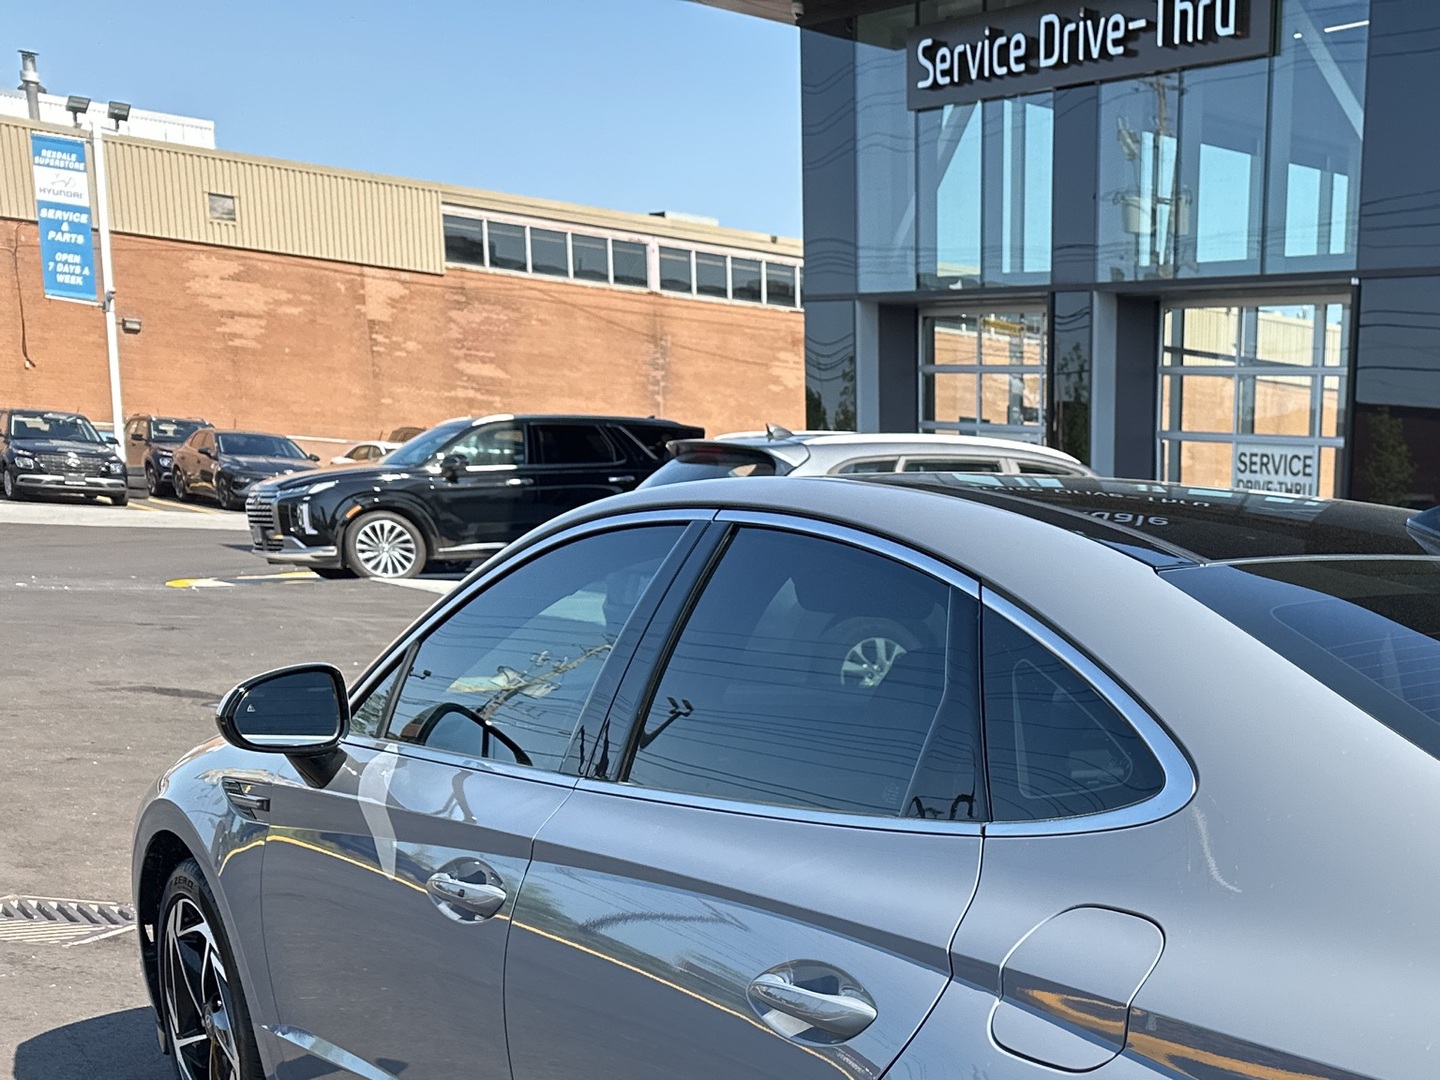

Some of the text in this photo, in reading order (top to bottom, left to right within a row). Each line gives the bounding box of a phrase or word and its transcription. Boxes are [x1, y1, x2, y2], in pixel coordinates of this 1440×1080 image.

[916, 26, 1026, 89] Service
[41, 149, 77, 161] REXDALE
[34, 156, 85, 170] SUPERSTORE
[39, 187, 83, 199] HYUNDAI
[40, 208, 89, 224] SERVICE
[48, 230, 84, 245] PARTS
[55, 252, 81, 264] OPEN
[48, 261, 90, 276] 7 DAYS A
[56, 273, 83, 286] WEEK
[1237, 452, 1313, 477] SERVICE
